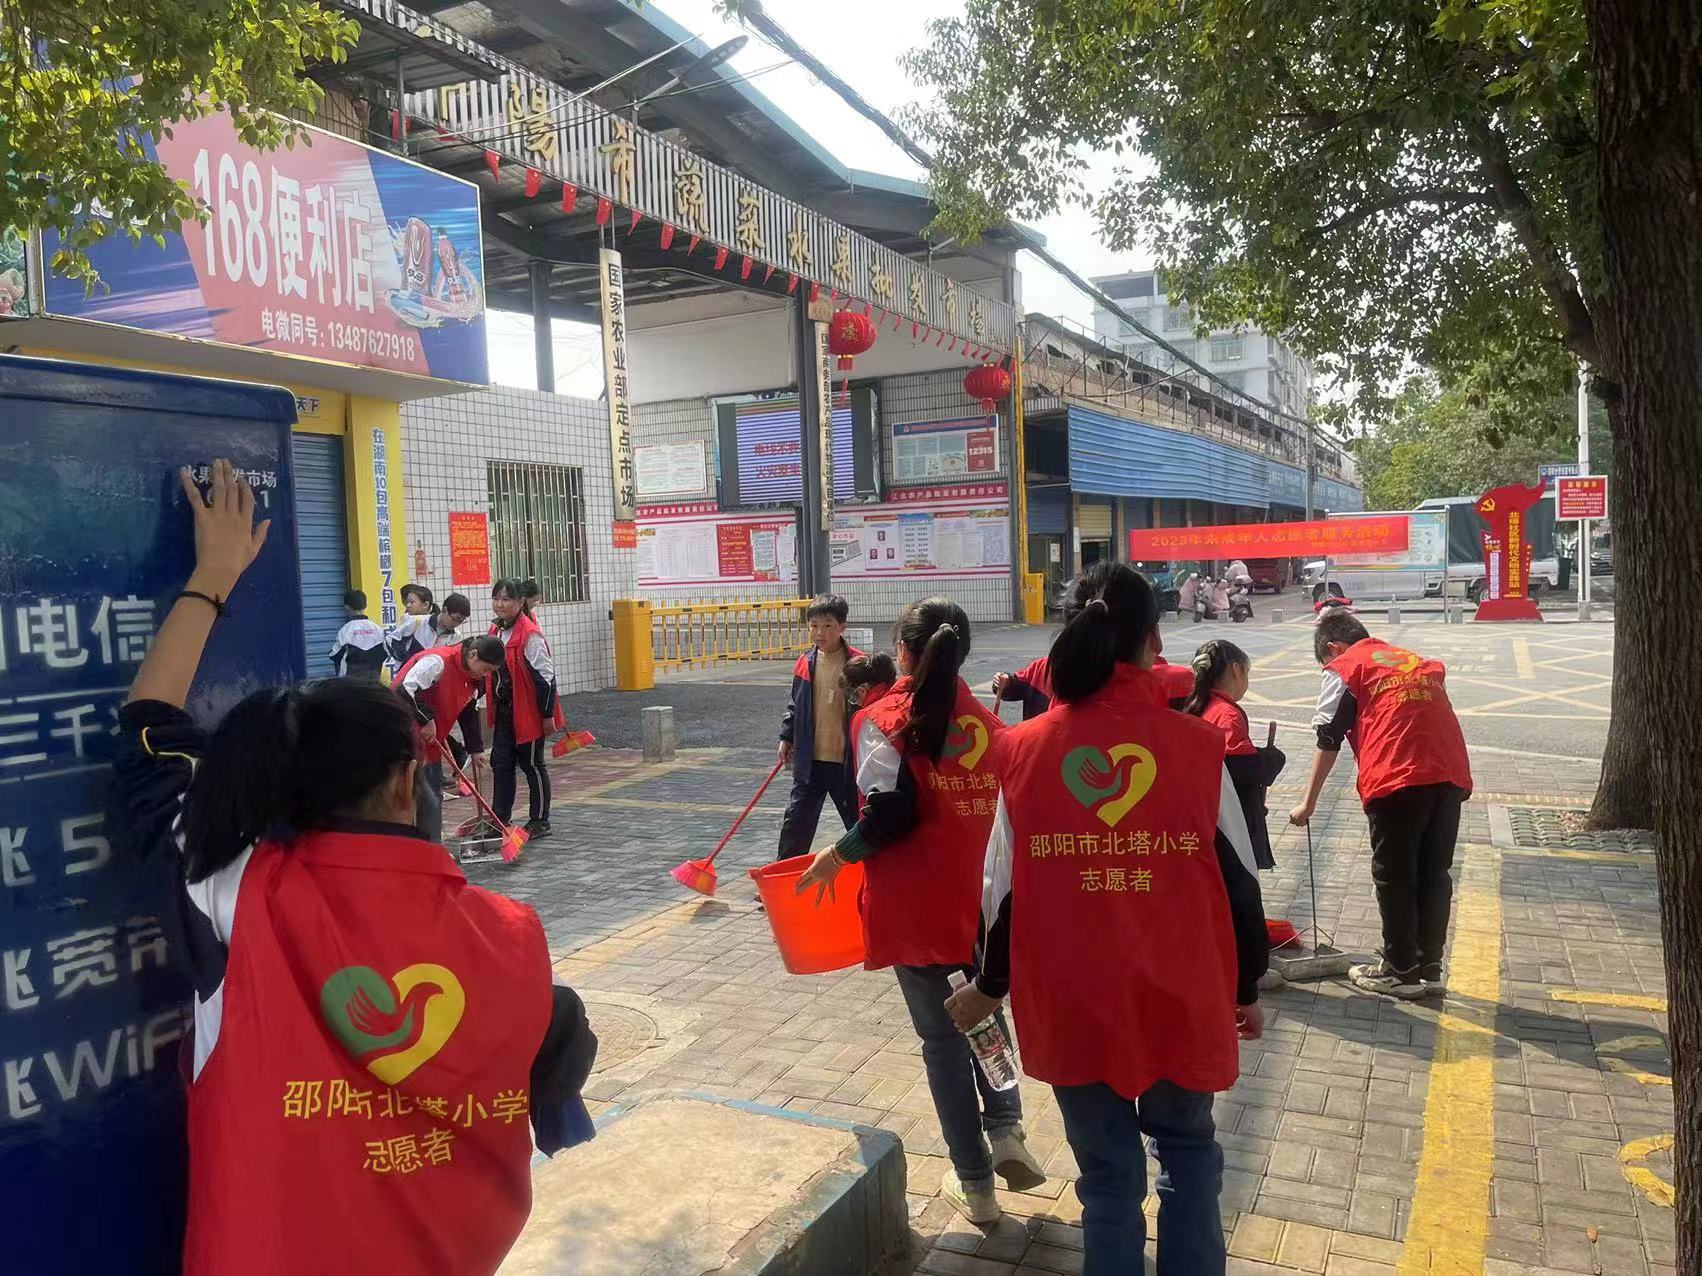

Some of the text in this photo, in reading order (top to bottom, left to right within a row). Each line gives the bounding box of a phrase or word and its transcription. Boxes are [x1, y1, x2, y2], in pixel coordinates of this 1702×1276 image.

[194, 148, 375, 314] 168便利店
[607, 262, 635, 508] 国家农业部定点市场
[968, 447, 993, 456] 12315
[187, 465, 277, 488] 水果发市场
[0, 593, 156, 670] 电信
[0, 703, 122, 767] 三千
[1030, 831, 1200, 858] 邵阳市北塔小学
[1080, 867, 1153, 892] 志愿者
[362, 1128, 455, 1174] 志愿者
